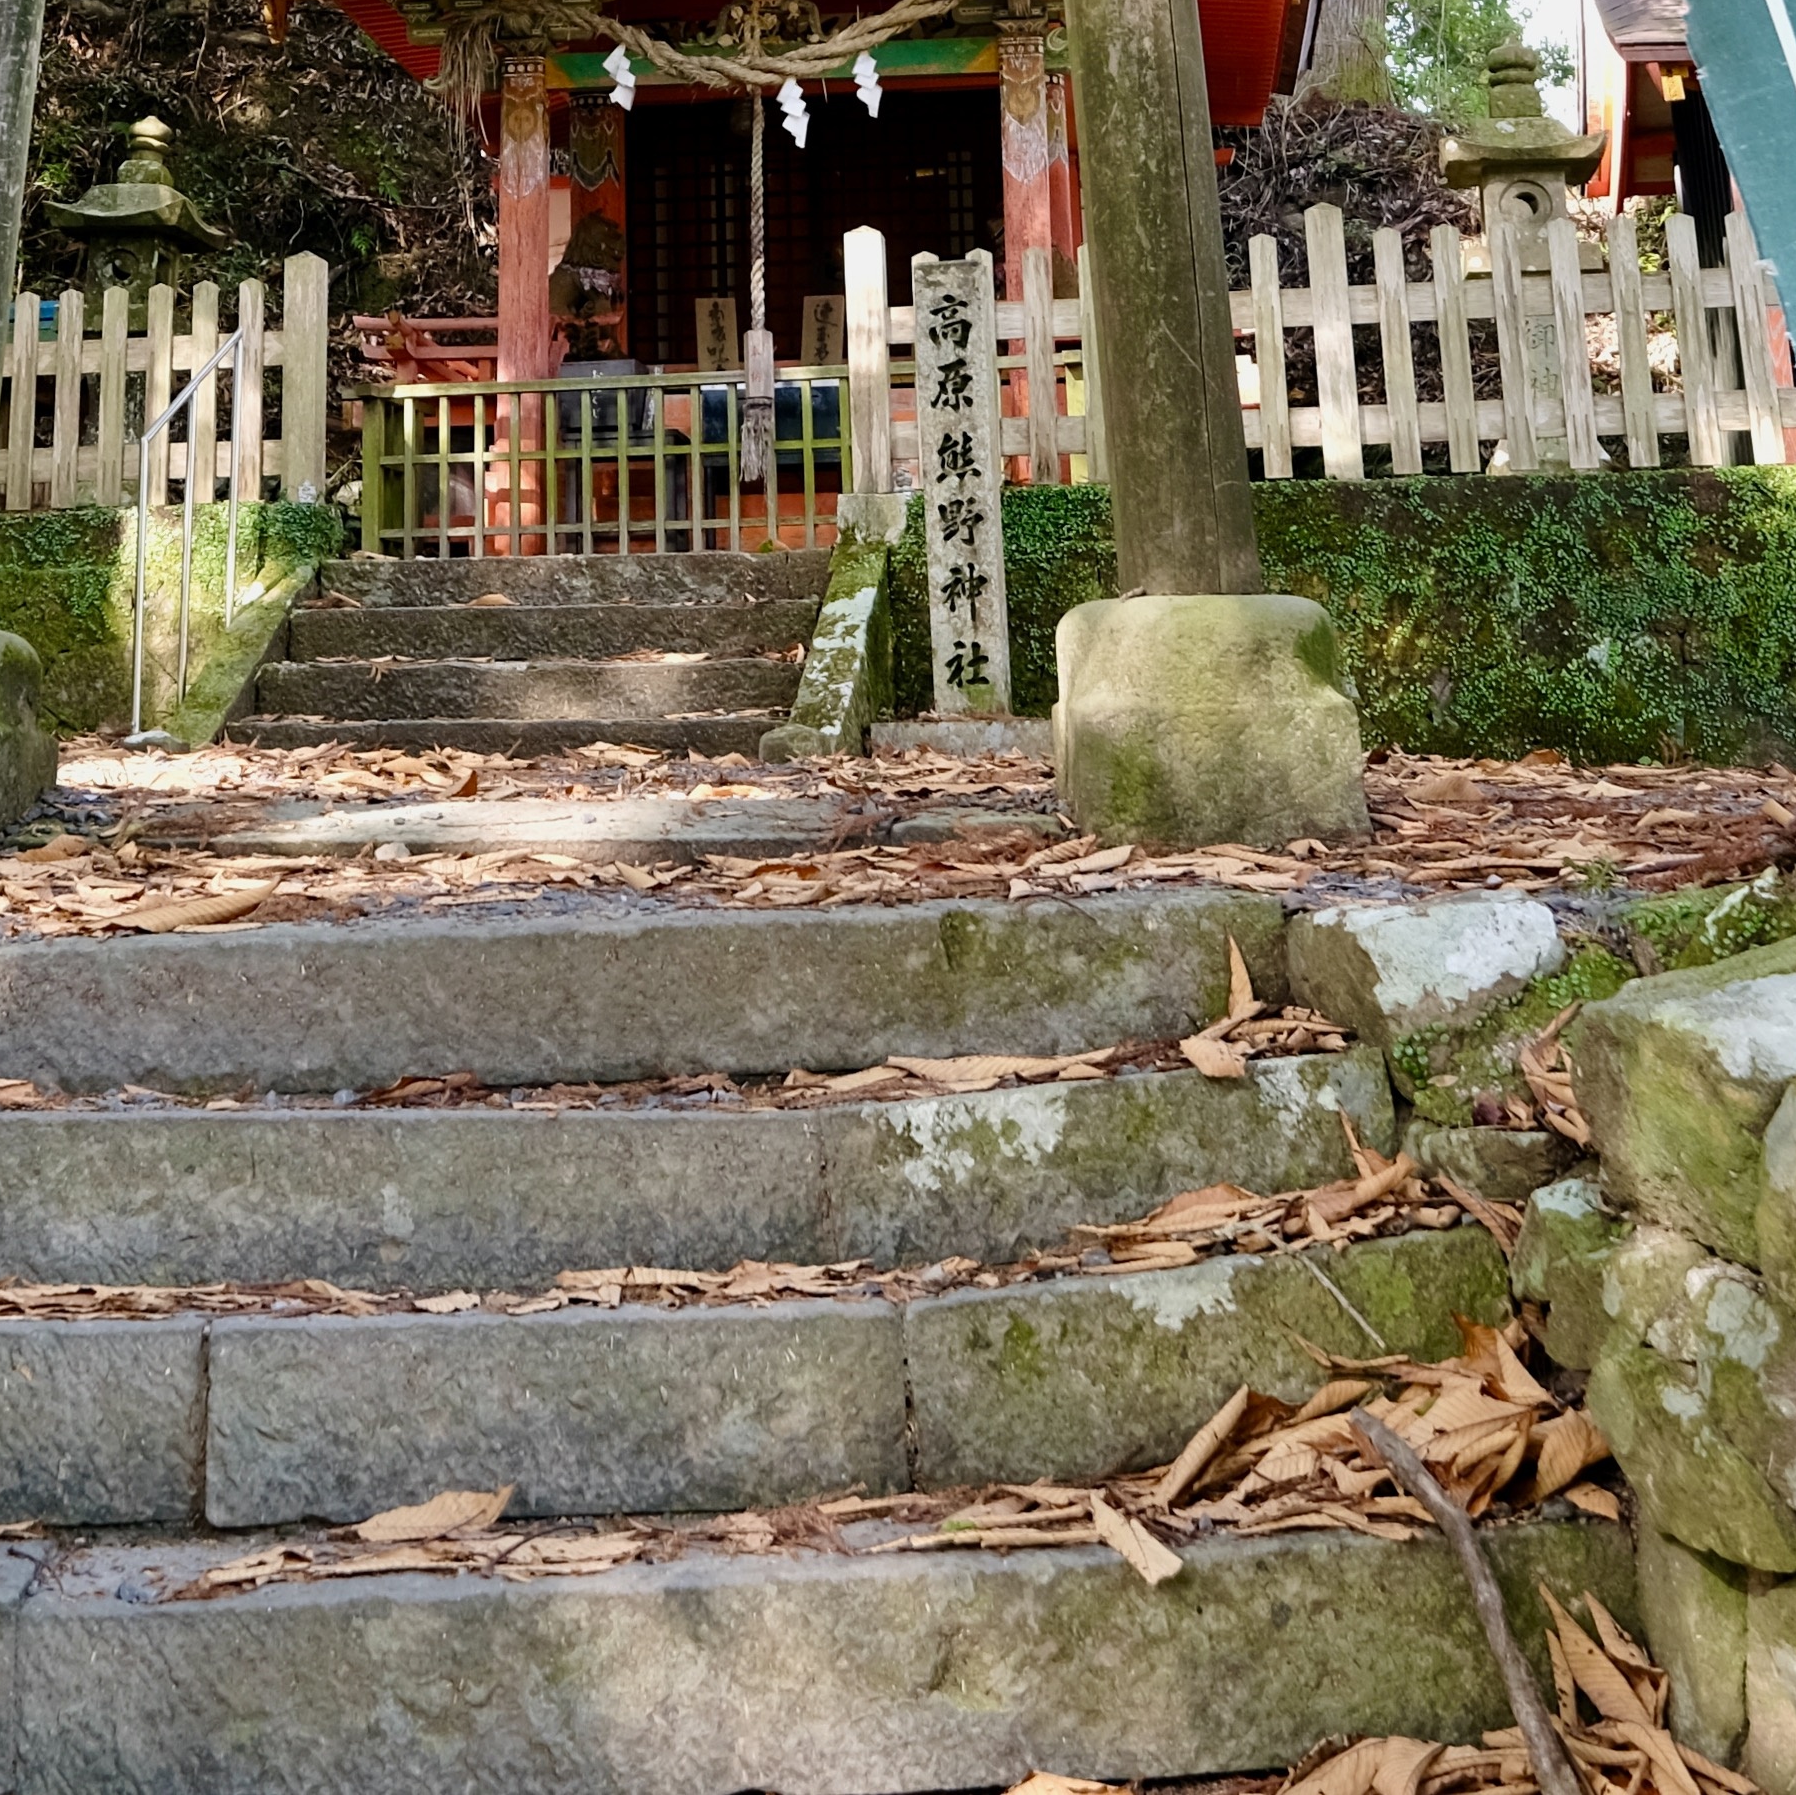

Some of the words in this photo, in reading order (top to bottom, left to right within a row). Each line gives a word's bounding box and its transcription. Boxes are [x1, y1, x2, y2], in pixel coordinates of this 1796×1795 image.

[928, 293, 990, 688] 高原熊野神社
